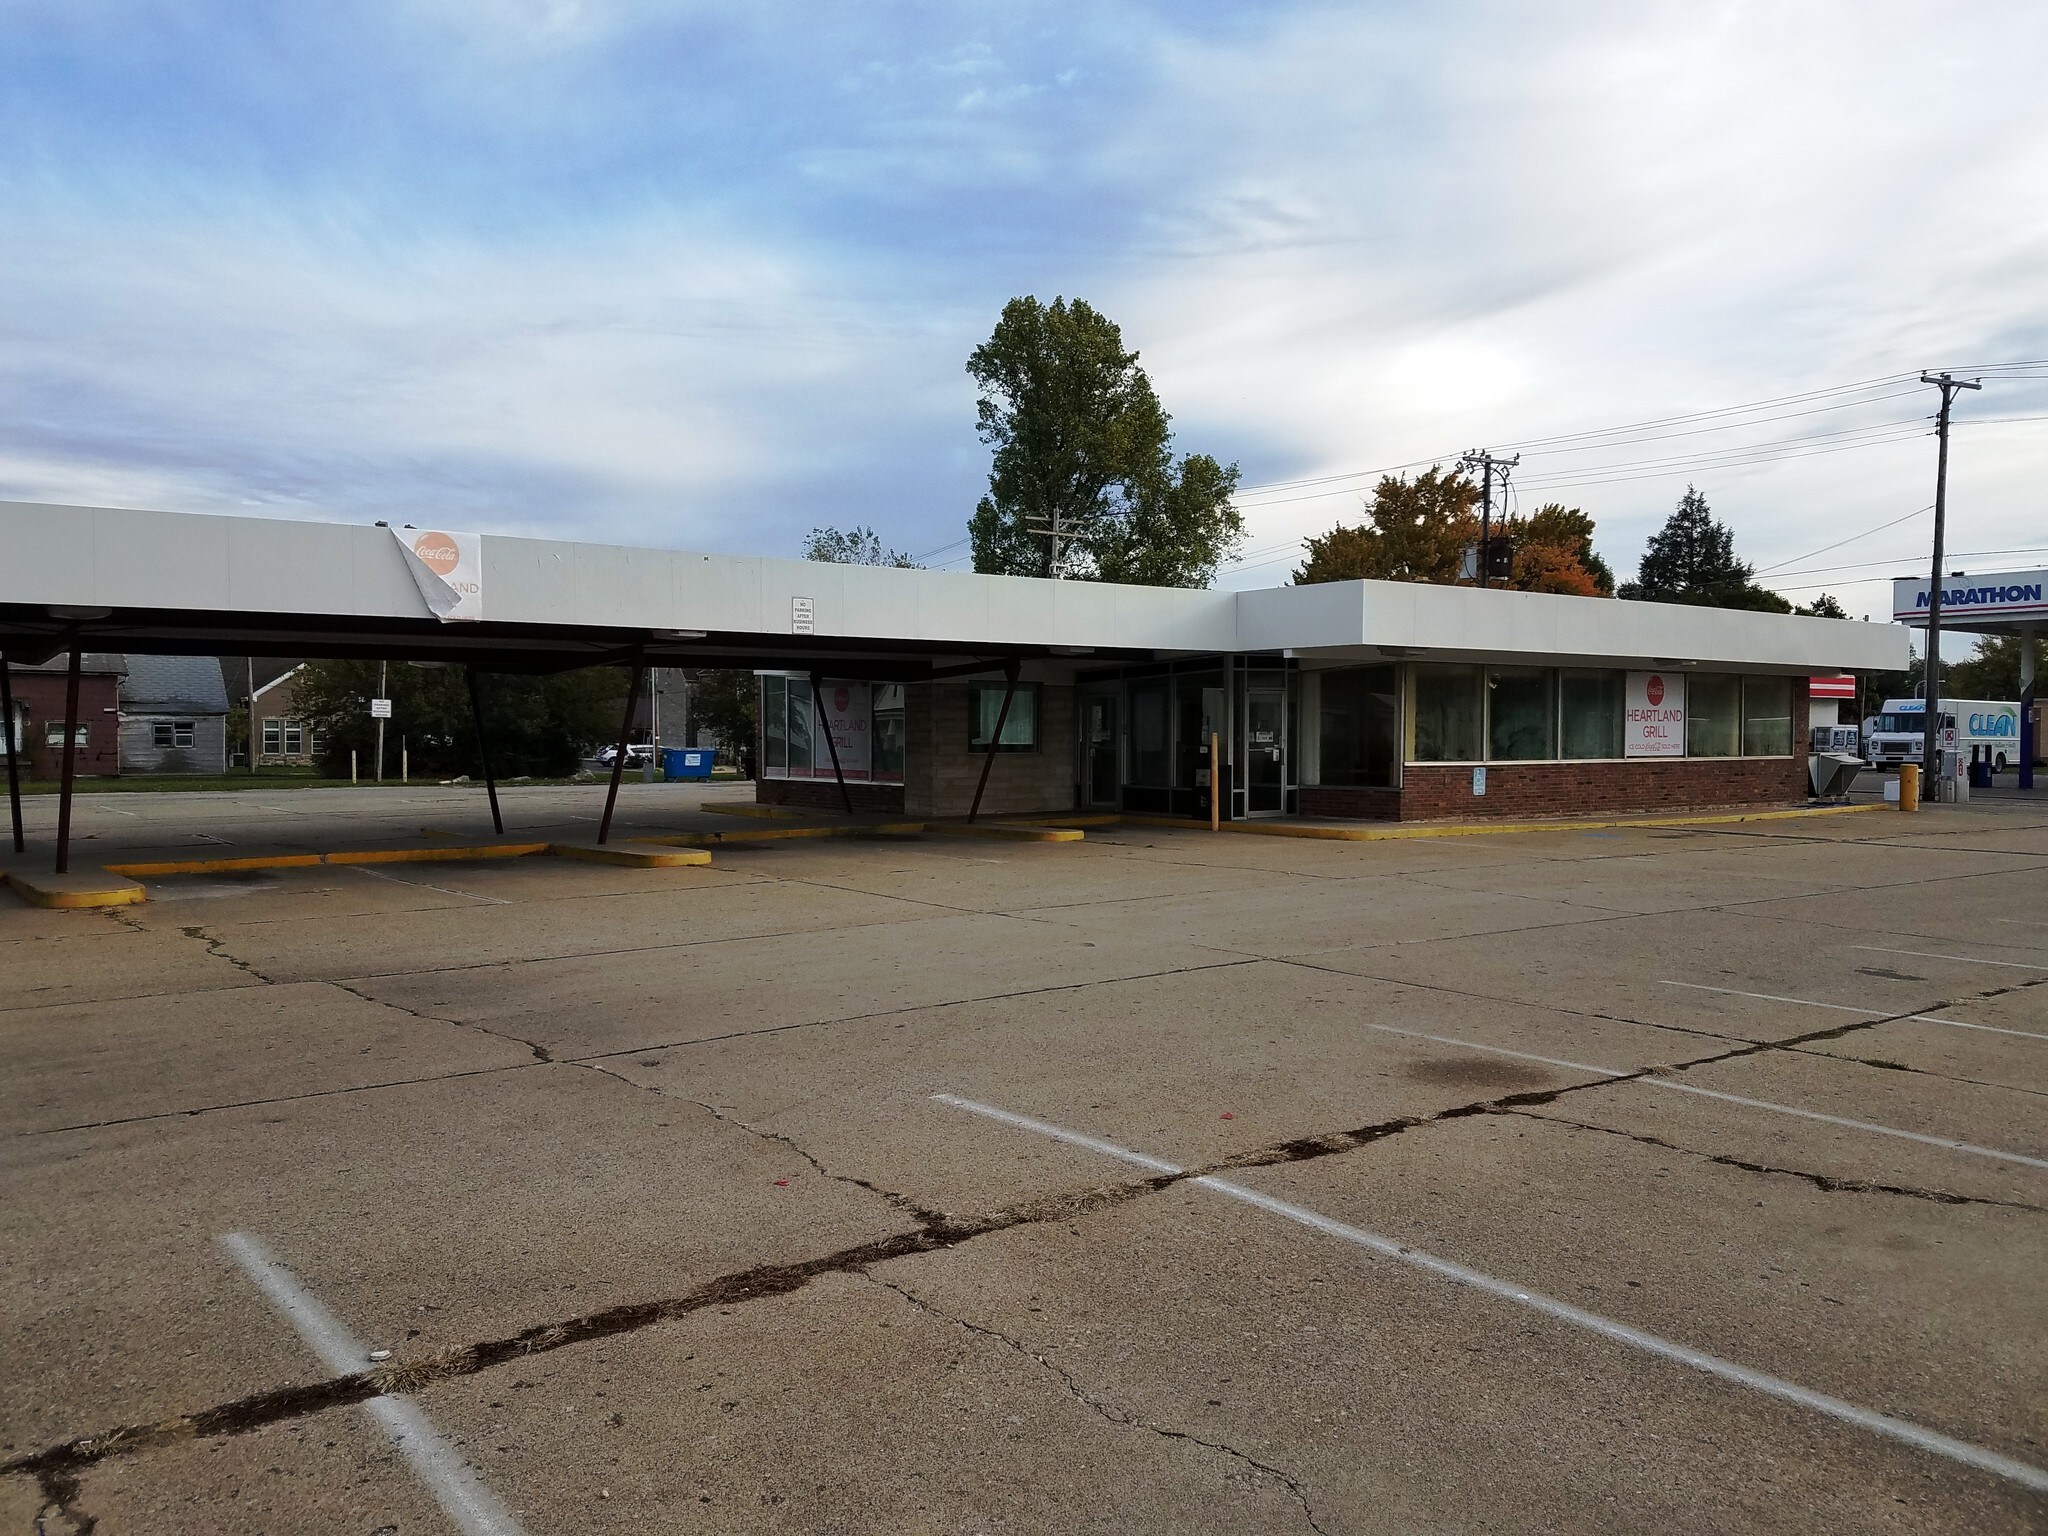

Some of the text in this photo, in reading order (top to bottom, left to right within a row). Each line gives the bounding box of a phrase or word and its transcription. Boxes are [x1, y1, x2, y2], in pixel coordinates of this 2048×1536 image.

[1626, 709, 1683, 722] HEARTLAND
[818, 720, 866, 731] HARTLAND
[1643, 725, 1668, 738] GRILL
[1969, 713, 2017, 737] CLEAN
